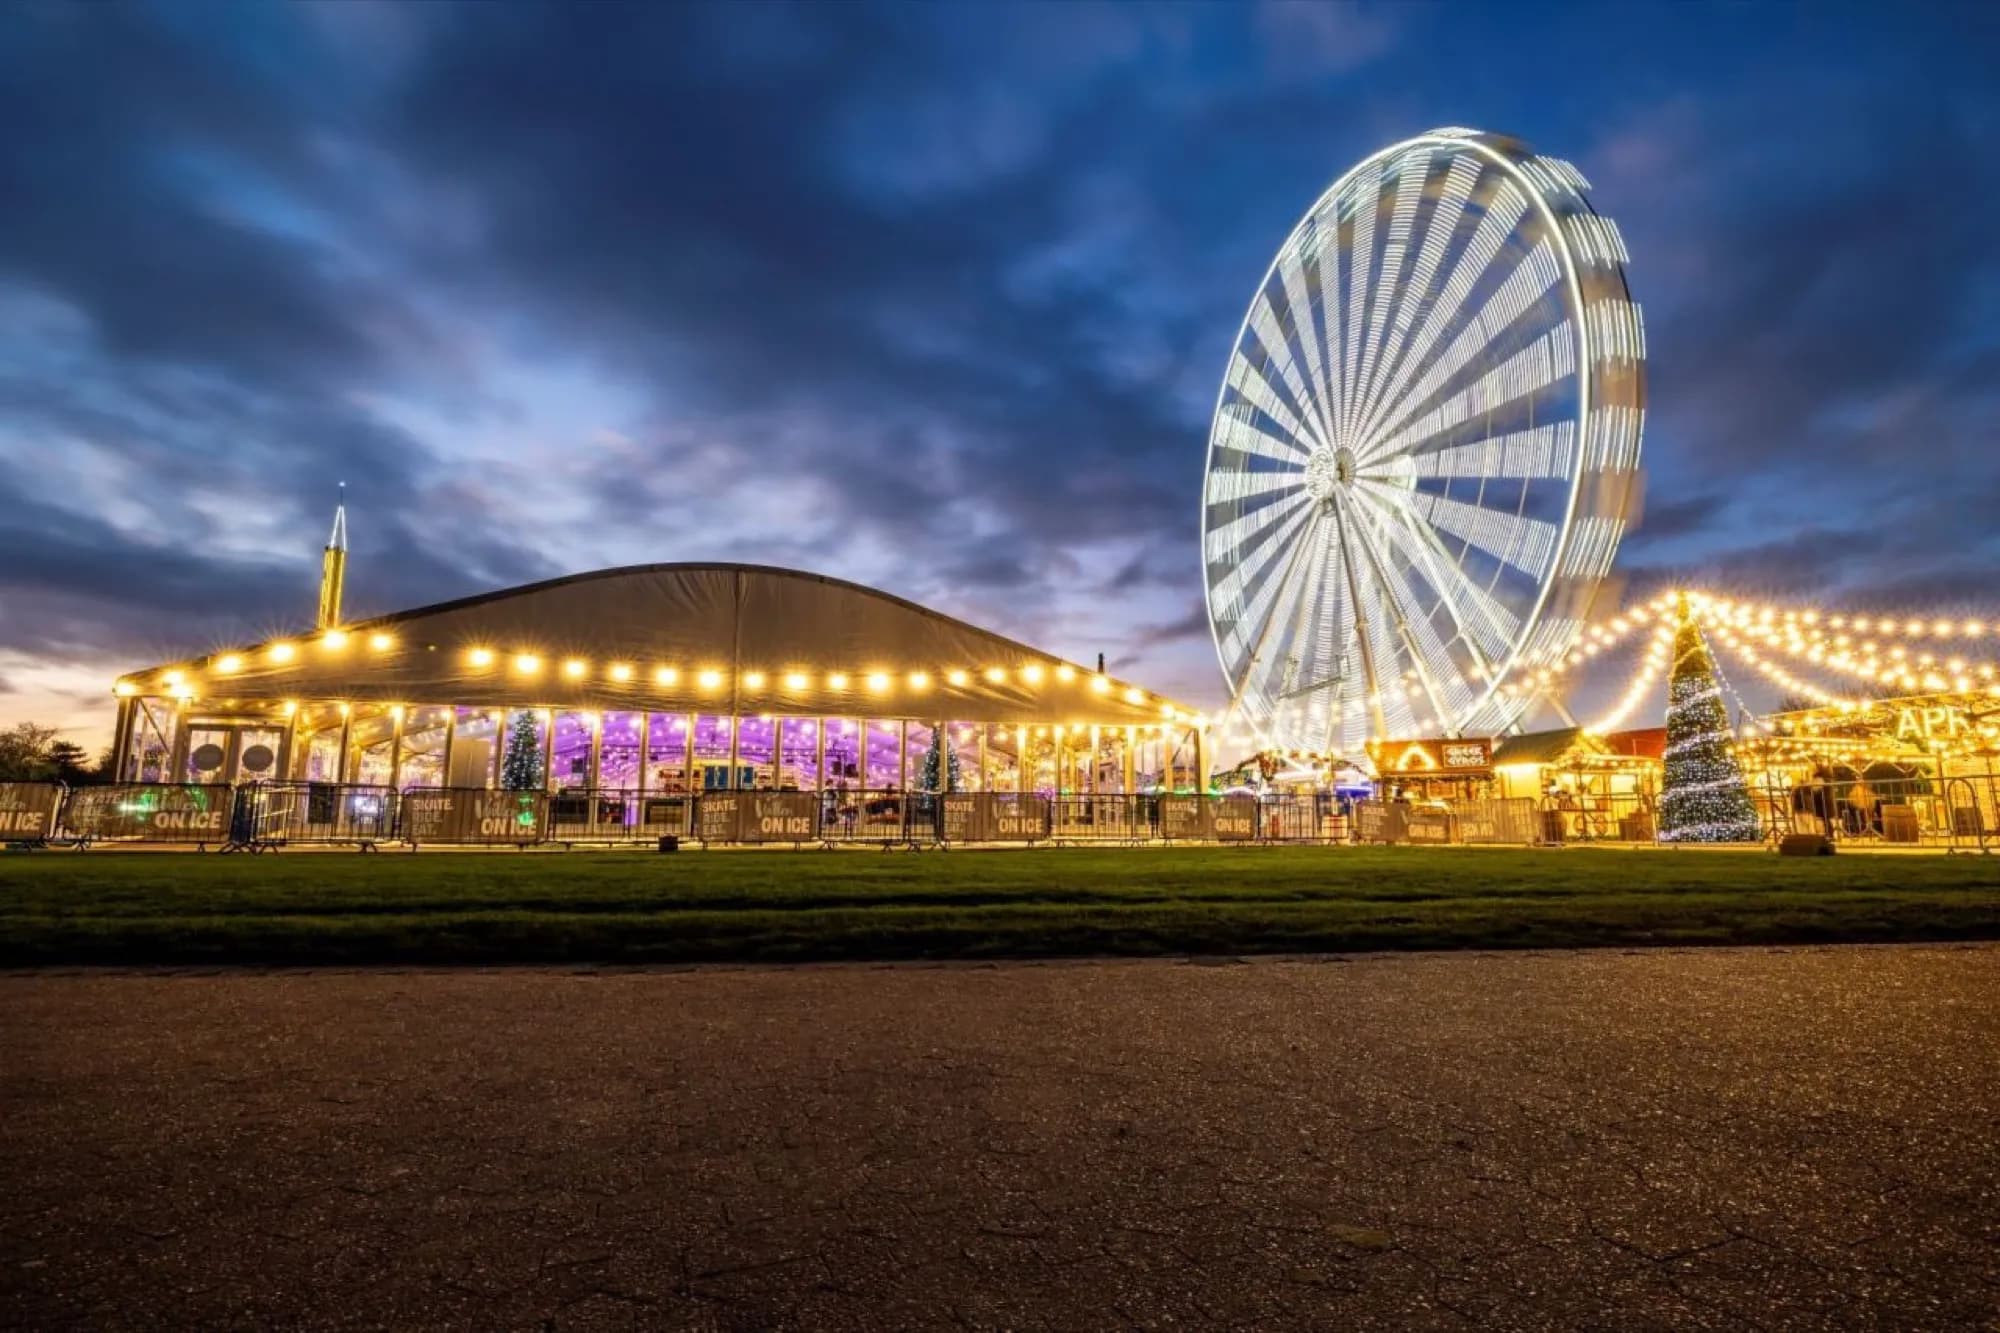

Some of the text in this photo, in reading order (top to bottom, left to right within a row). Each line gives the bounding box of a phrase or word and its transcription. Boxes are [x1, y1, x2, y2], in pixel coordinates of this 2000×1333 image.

[15, 812, 45, 831] ICE
[154, 811, 222, 829] ON ICE
[480, 817, 537, 836] ON ICE
[761, 816, 810, 834] ON ICE
[999, 818, 1043, 834] ON ICE
[1215, 818, 1251, 833] ON ICE
